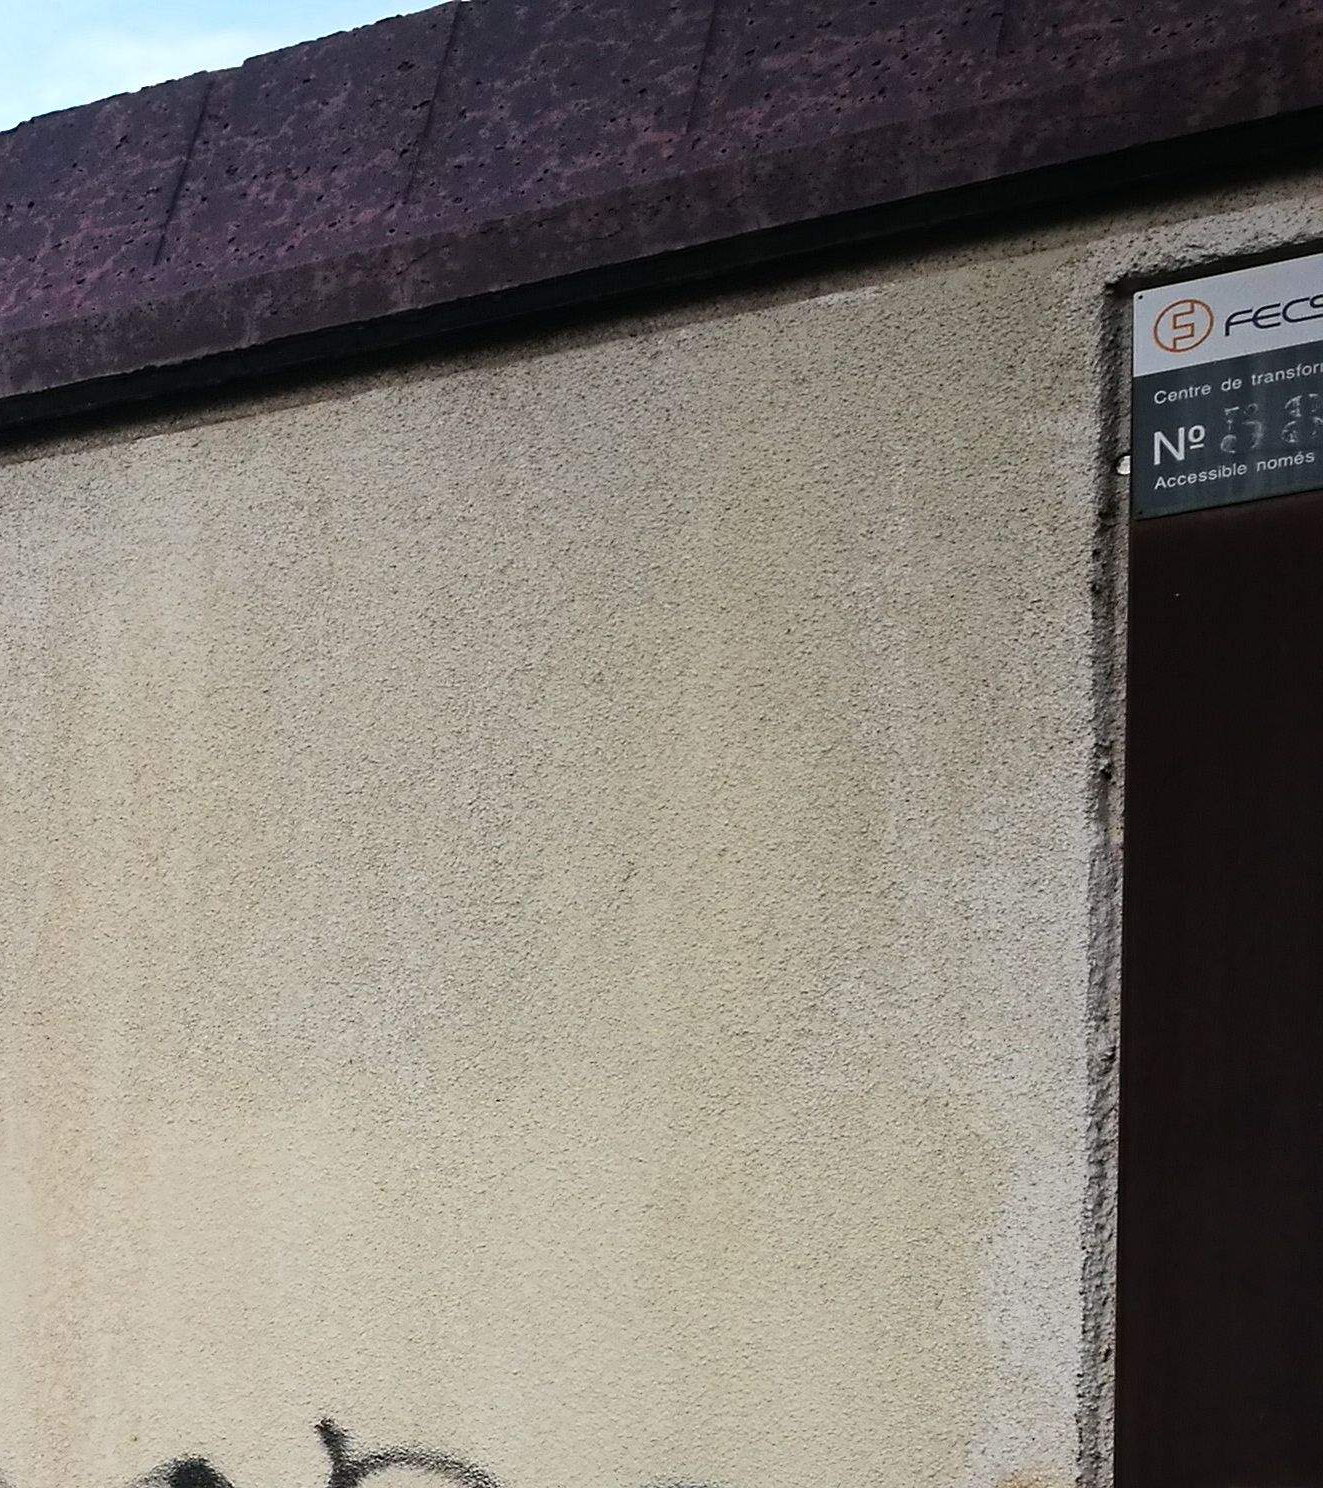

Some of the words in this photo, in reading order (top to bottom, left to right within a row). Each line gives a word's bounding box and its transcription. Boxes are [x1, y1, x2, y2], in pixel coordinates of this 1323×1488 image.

[1154, 384, 1212, 404] Centre
[1221, 378, 1243, 392] de
[1154, 463, 1248, 490] Accessible
[1256, 450, 1316, 472] només
